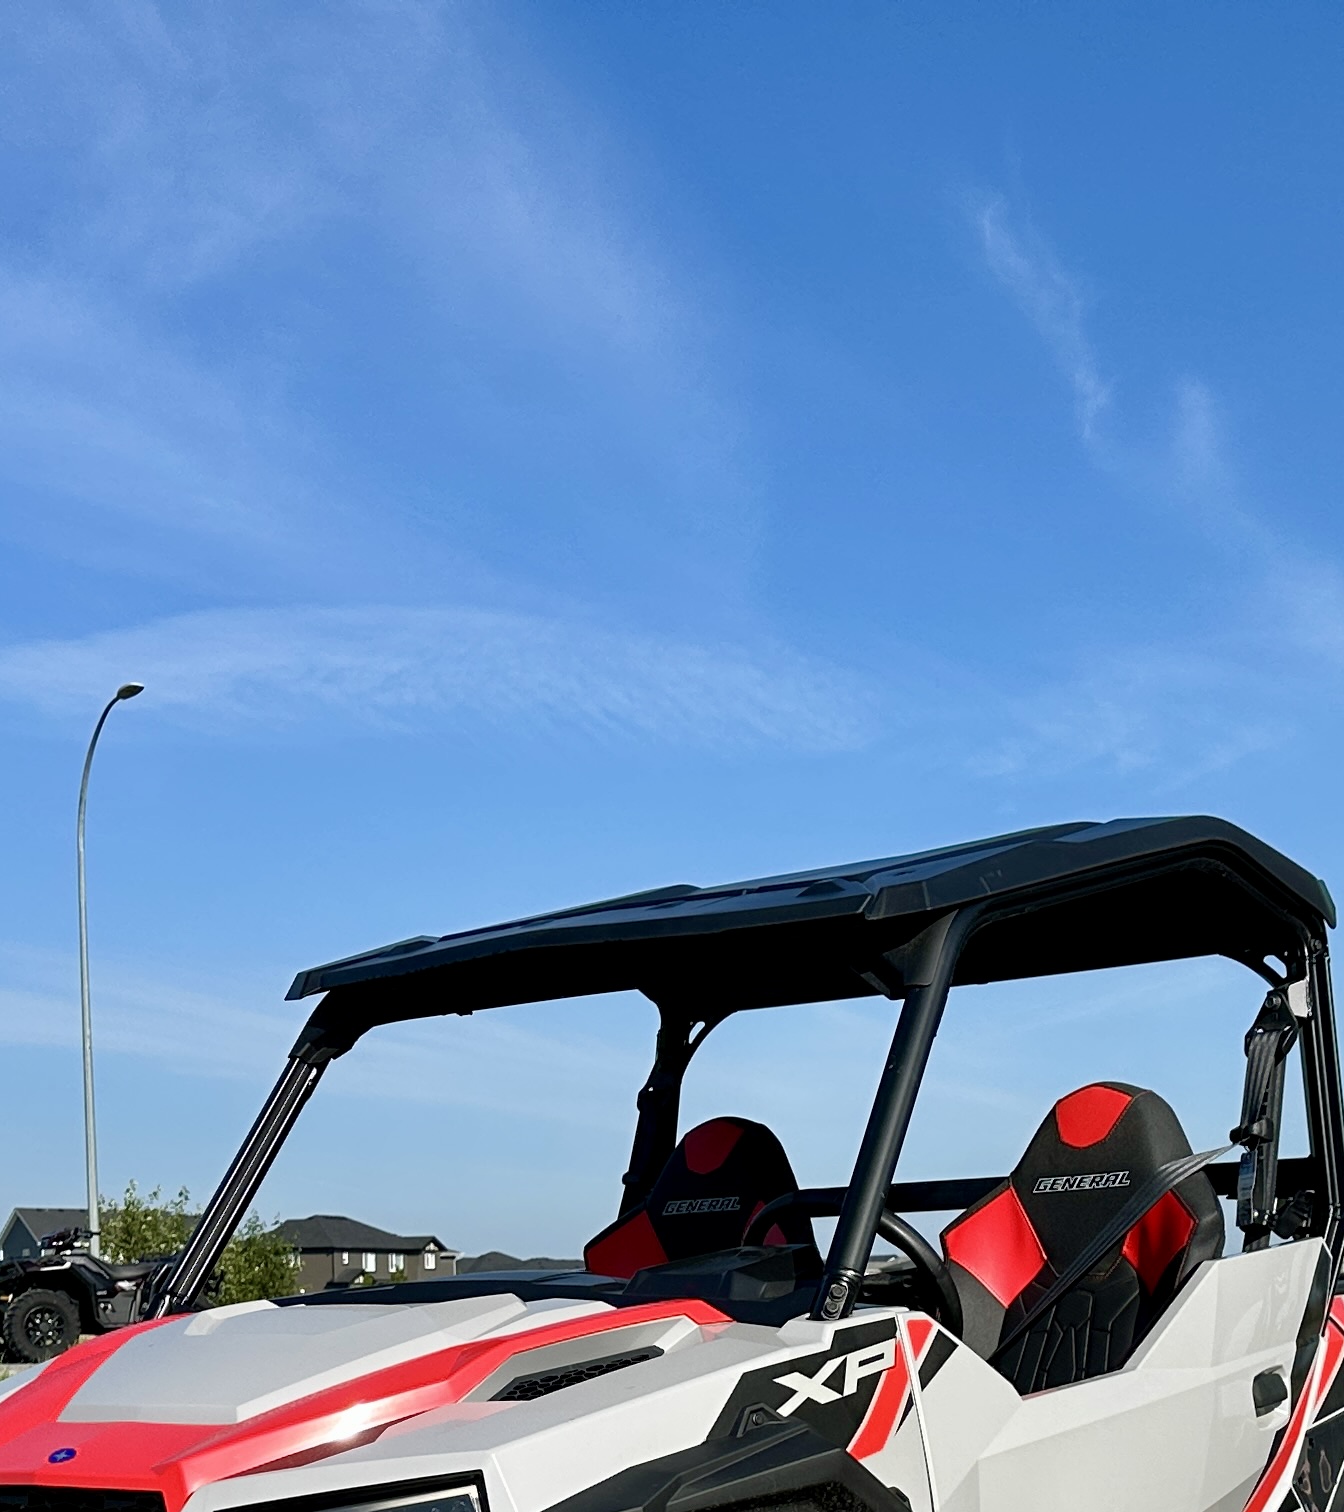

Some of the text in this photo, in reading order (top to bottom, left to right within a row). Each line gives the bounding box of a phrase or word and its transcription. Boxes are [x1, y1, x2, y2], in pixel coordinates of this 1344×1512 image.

[1032, 1171, 1131, 1194] GENERAL
[662, 1196, 741, 1216] GENERAL
[772, 1337, 897, 1418] XP
